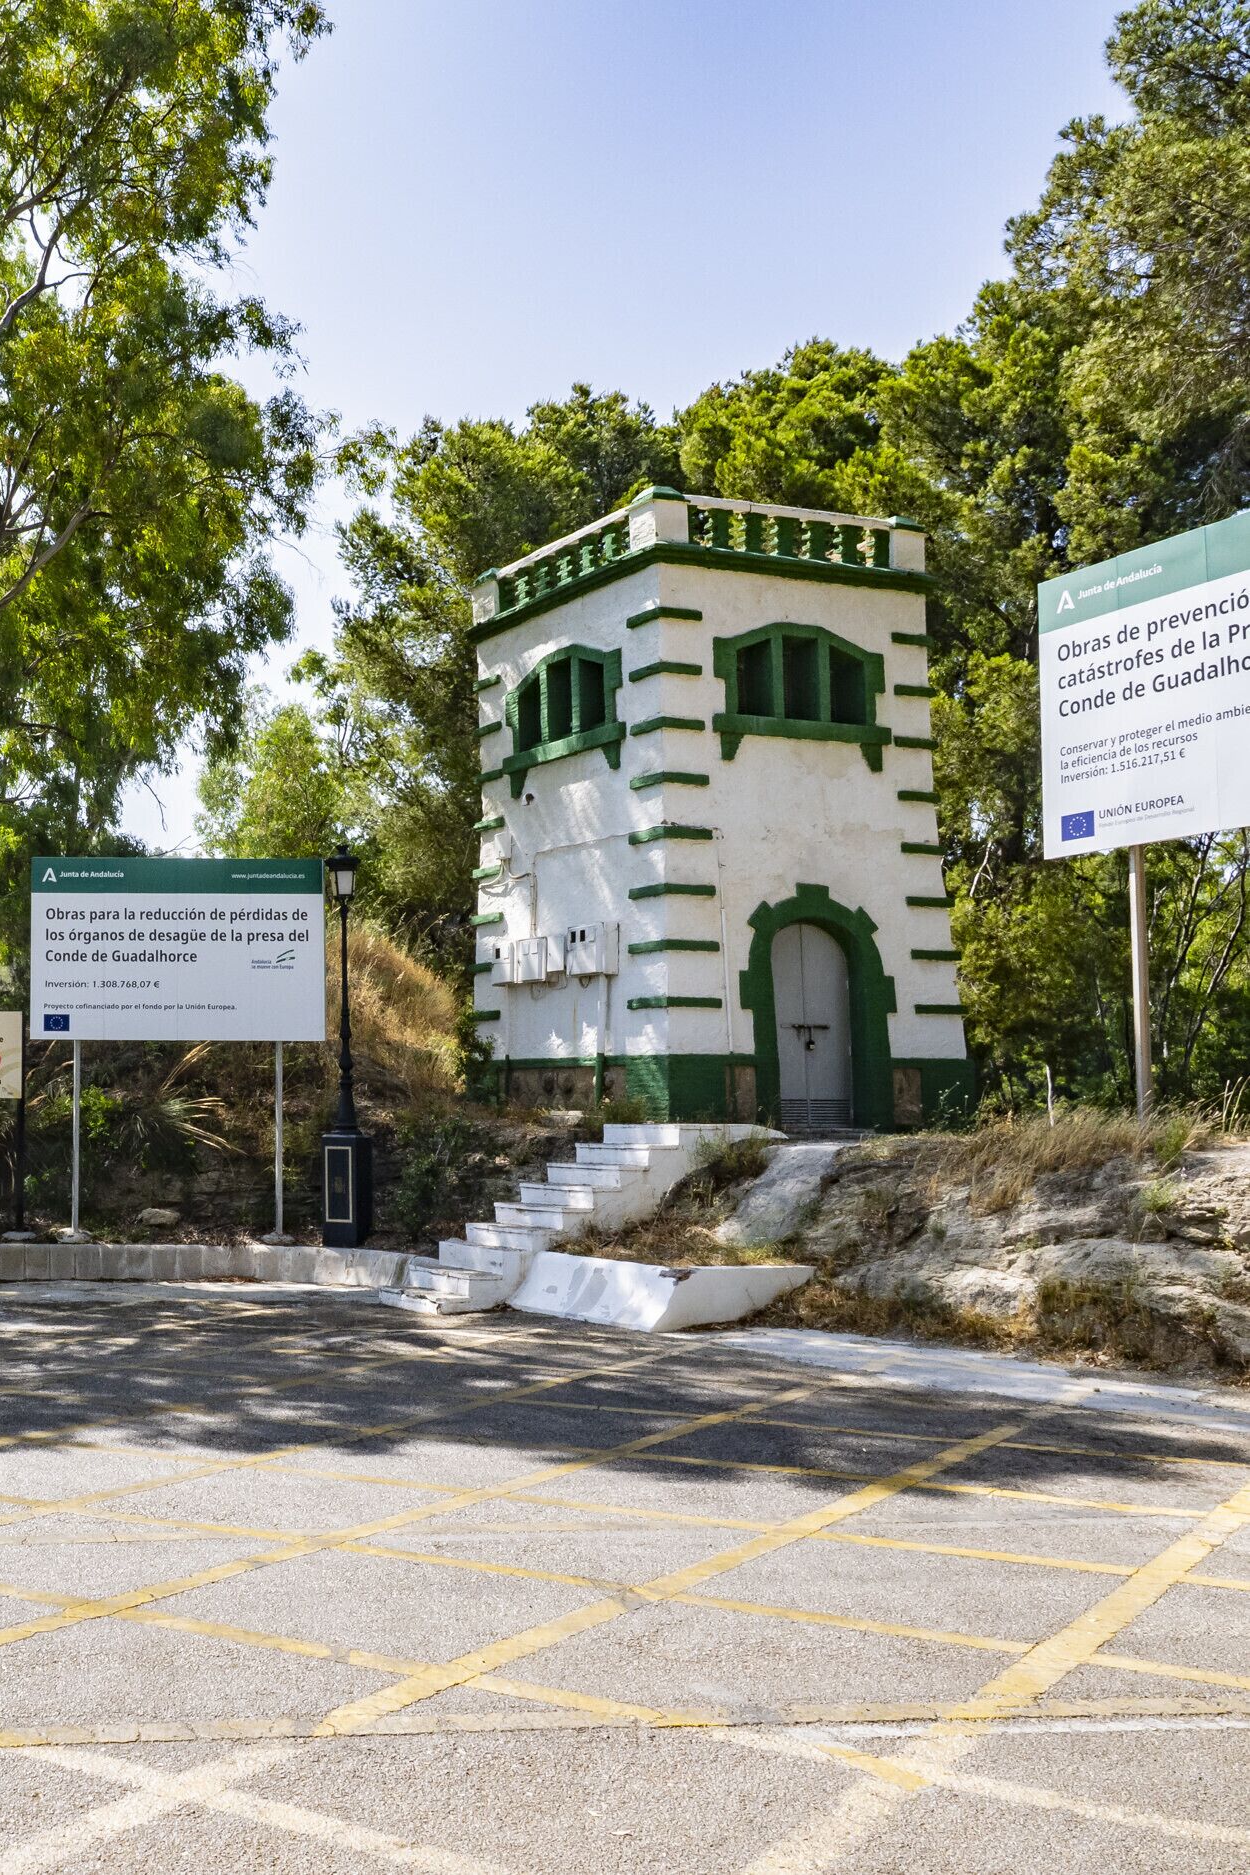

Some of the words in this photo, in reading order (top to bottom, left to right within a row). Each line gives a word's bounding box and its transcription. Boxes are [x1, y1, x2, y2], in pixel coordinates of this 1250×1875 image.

[1077, 584, 1102, 600] Junta
[1103, 580, 1116, 591] de
[1116, 564, 1162, 587] Andalucía
[1057, 632, 1111, 661] Obras
[1117, 625, 1139, 644] de
[1058, 644, 1164, 689] catástrofes
[1171, 637, 1195, 659] de
[1203, 630, 1220, 650] la
[1059, 689, 1116, 717] Conde
[1122, 682, 1145, 701] de
[1060, 737, 1108, 756] Conservar
[1110, 737, 1116, 746] y
[1118, 724, 1162, 745] proteger
[1166, 722, 1175, 732] el
[1177, 712, 1212, 730] medio
[1060, 760, 1069, 770] la
[1071, 749, 1117, 768] eficiencia
[1119, 745, 1132, 756] de
[1134, 741, 1149, 753] los
[1152, 732, 1198, 749] recursos
[1060, 765, 1109, 784] Inversión:
[1111, 751, 1176, 773] 1.516.217,51
[1179, 749, 1185, 758] €
[1099, 804, 1132, 819] UNIÓN
[1135, 795, 1184, 812] EUROPEA
[59, 871, 79, 879] Junta
[90, 870, 124, 878] Andalucía
[232, 872, 305, 880] www.juntadeandalucia.es
[46, 908, 86, 921] Obras
[89, 910, 120, 923] para
[124, 908, 135, 921] la
[140, 908, 205, 921] reducción
[210, 909, 226, 921] de
[230, 909, 288, 924] pérdidas
[292, 909, 308, 921] de
[46, 929, 64, 941] los
[69, 929, 124, 944] órganos
[129, 929, 145, 942] de
[149, 930, 206, 945] desagüe
[211, 930, 226, 942] de
[231, 930, 242, 942] la
[247, 932, 284, 944] presa
[288, 930, 309, 942] del
[46, 950, 87, 962] Conde
[91, 950, 108, 962] de
[112, 950, 197, 962] Guadalhorce
[45, 980, 90, 988] Inversión:
[92, 980, 151, 989] 1.308.768,07
